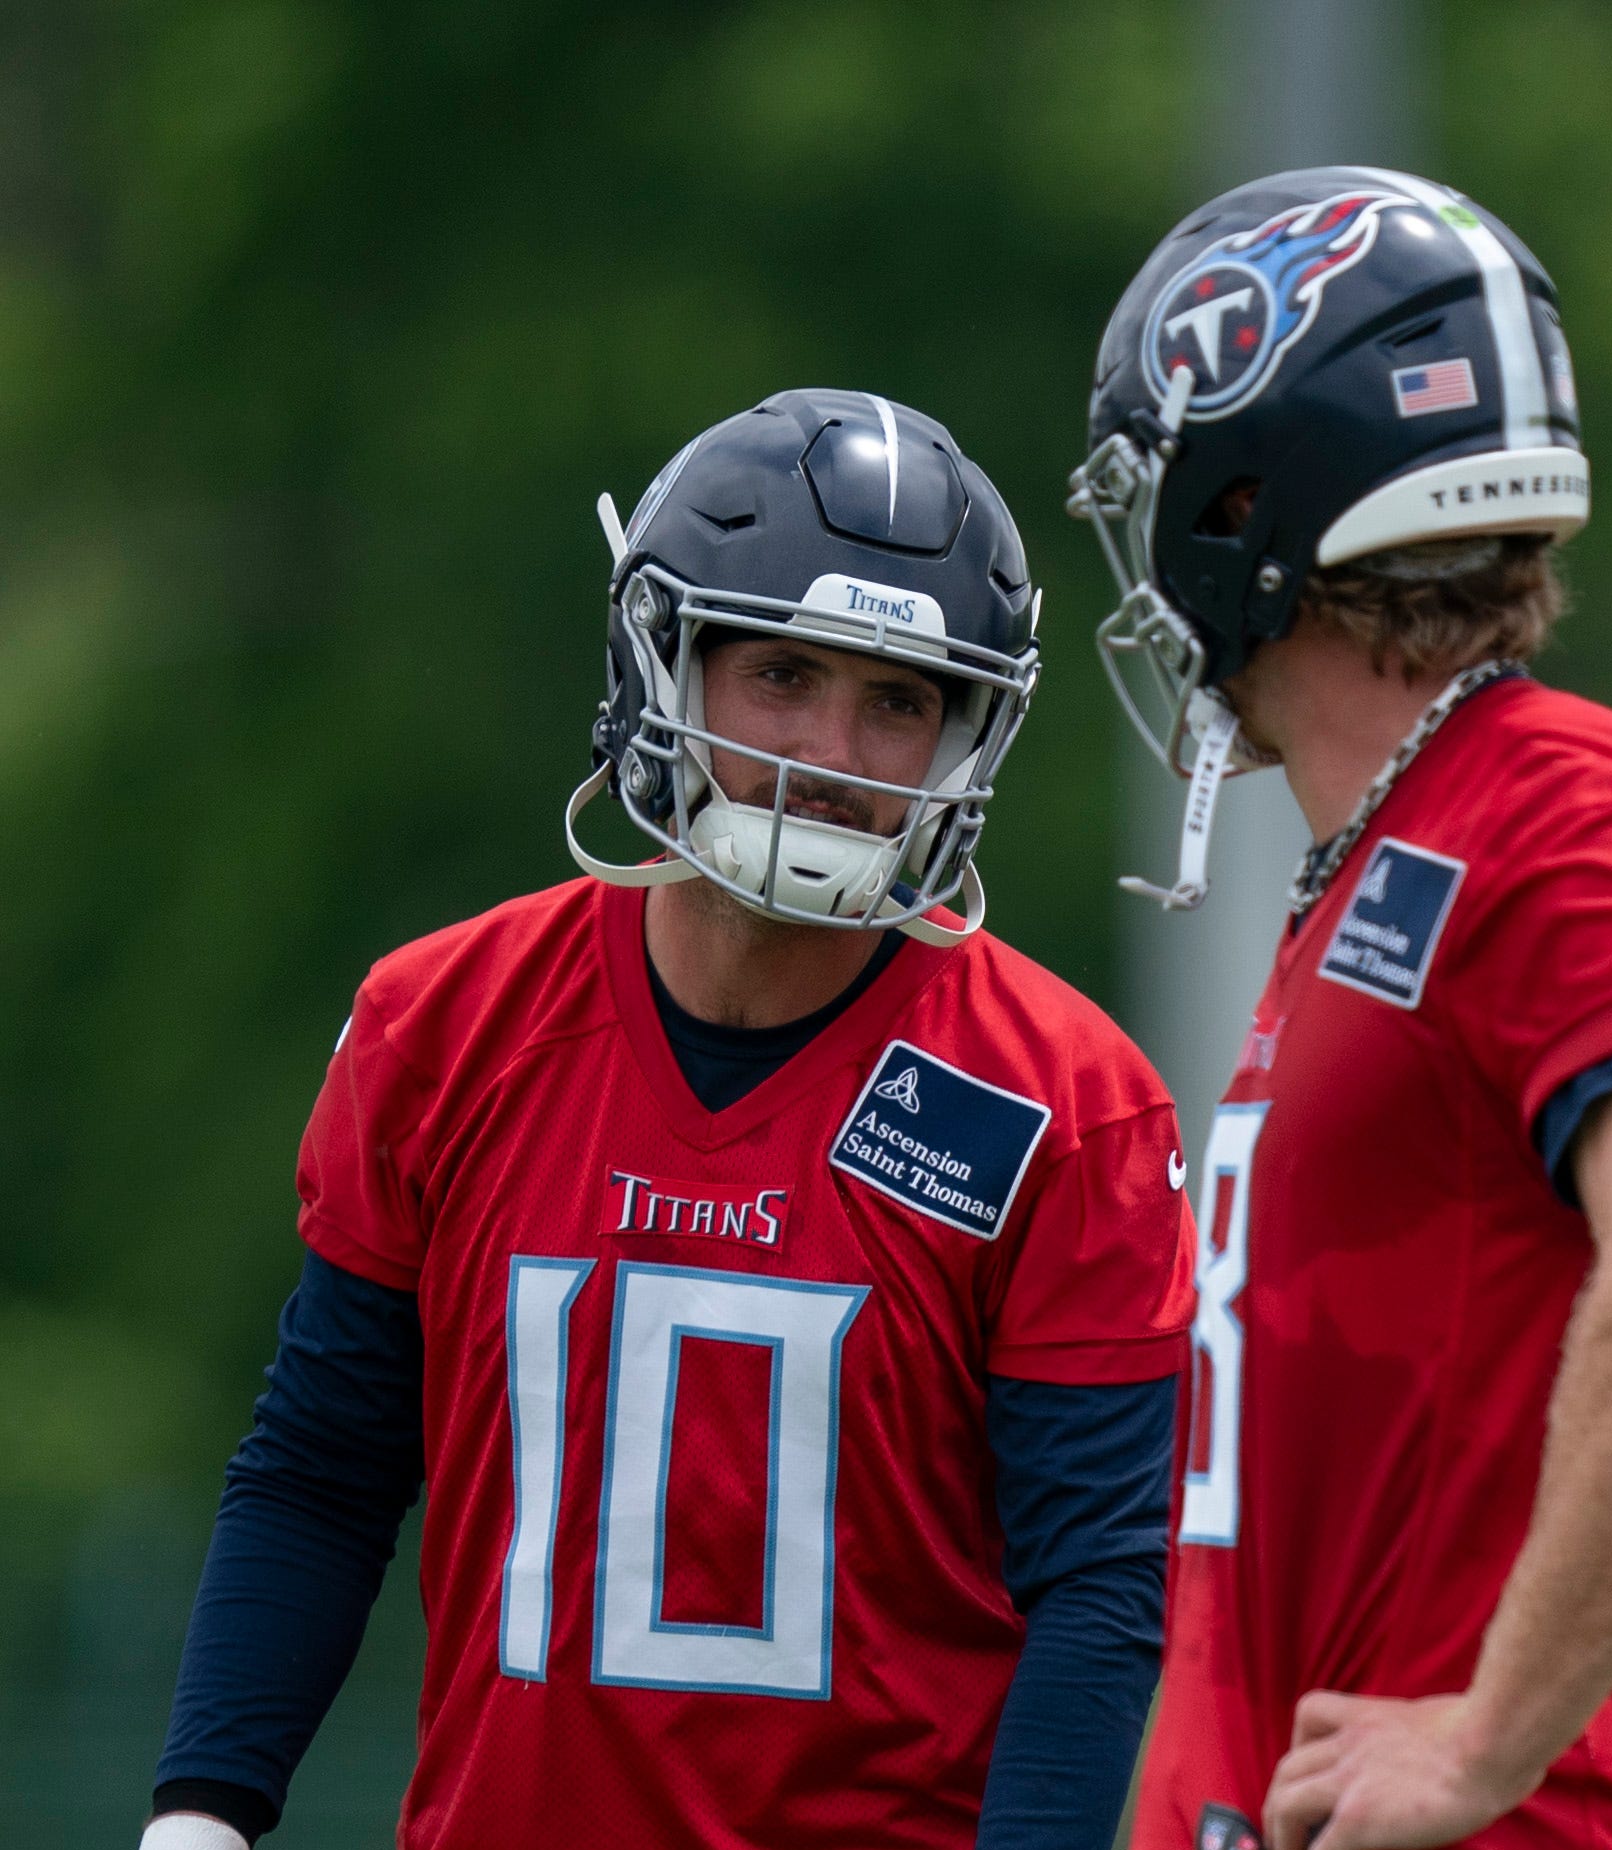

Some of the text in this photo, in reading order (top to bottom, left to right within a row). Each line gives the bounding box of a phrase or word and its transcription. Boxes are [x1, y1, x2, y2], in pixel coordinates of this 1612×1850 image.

[846, 584, 916, 623] TITANS
[843, 1132, 998, 1222] Saint Thomas
[856, 1110, 972, 1182] Ascension
[610, 1170, 787, 1247] TITANS
[499, 1254, 873, 1701] 10
